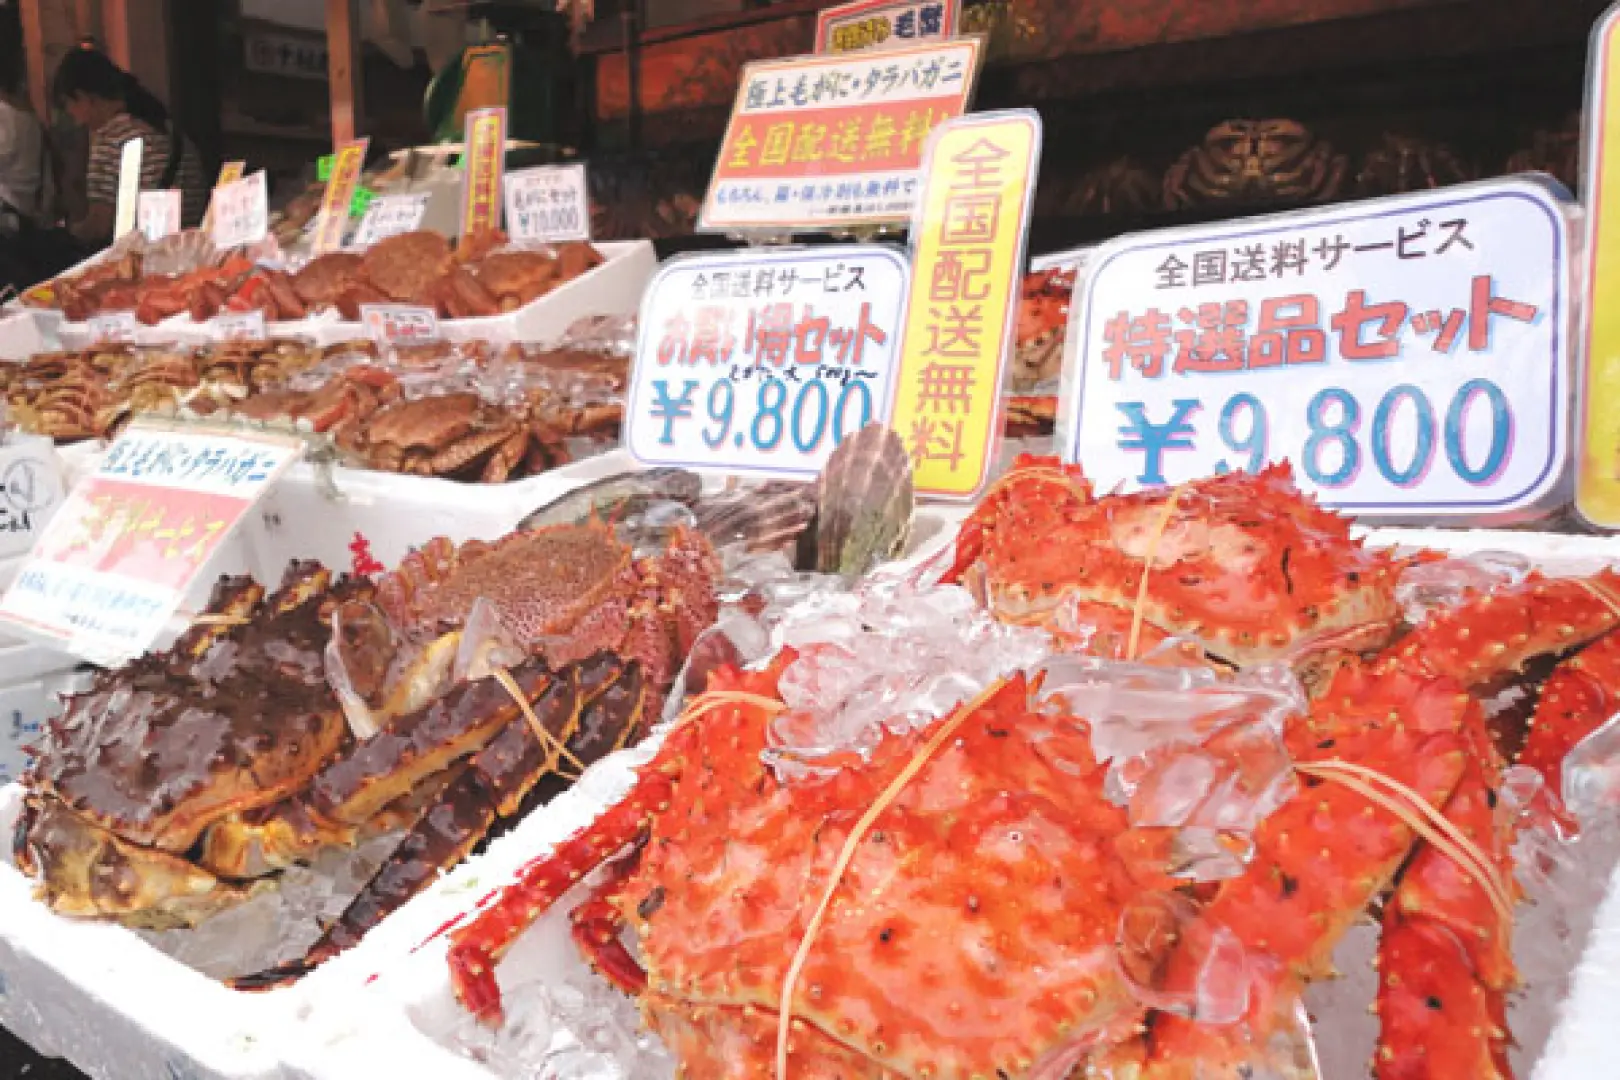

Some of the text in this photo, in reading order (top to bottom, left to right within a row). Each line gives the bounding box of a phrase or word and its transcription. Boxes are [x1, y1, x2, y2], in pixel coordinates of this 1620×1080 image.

[728, 107, 950, 168] 全国配送無料
[690, 263, 867, 299] 全国送料サービス
[1154, 217, 1475, 290] 全国送料サービス
[909, 137, 1011, 473] 全国配送無料
[1102, 275, 1541, 381] 特選品セット
